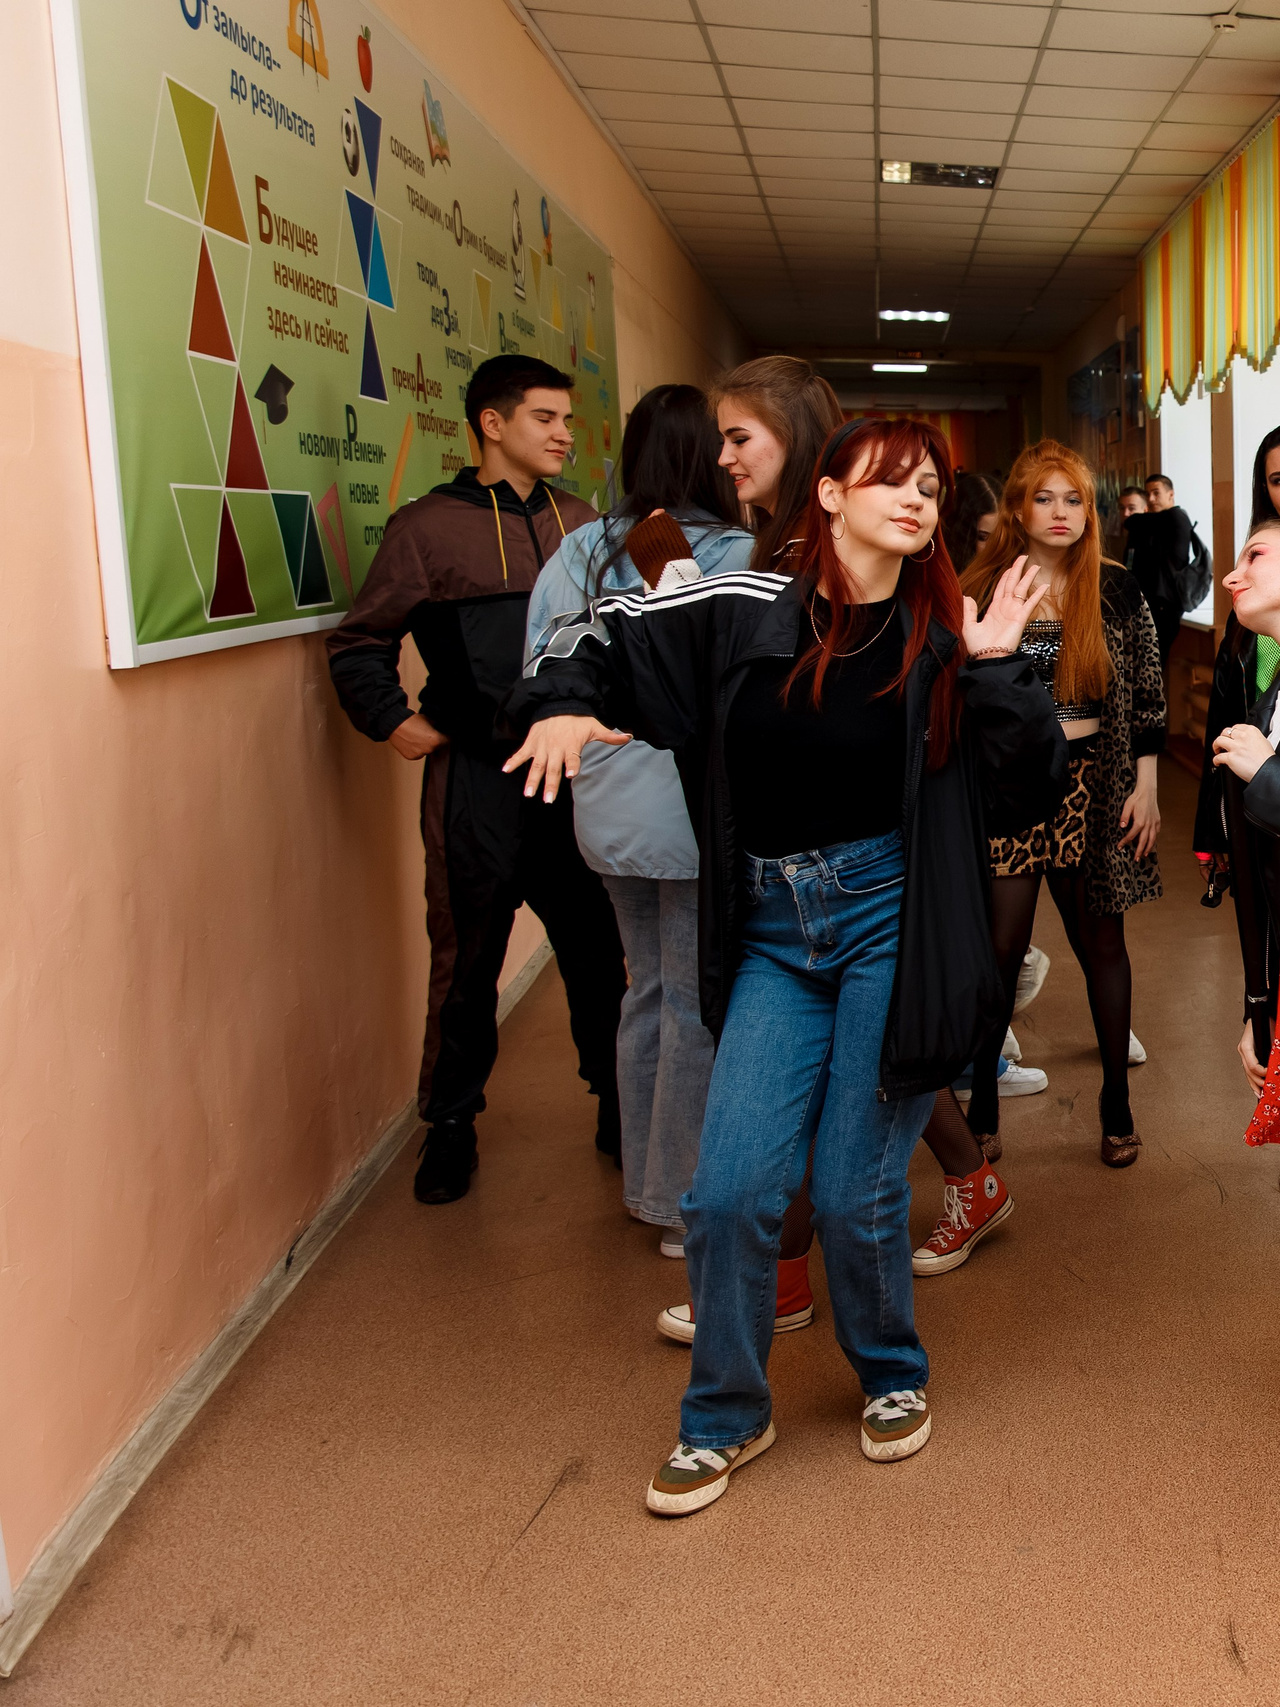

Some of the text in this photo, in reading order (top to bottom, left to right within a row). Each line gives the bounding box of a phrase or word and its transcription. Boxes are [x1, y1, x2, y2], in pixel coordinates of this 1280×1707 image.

[230, 69, 315, 147] до результата
[390, 135, 425, 178] сохраняя
[255, 174, 318, 257] Будущее
[406, 184, 444, 231] традиции,
[273, 261, 338, 308] начинается
[416, 261, 440, 295] твори,
[267, 306, 349, 355] здесь и сейчас
[431, 288, 461, 337] дерЗай,
[392, 352, 443, 404] прекрАсное
[299, 404, 387, 467] новому вРемени-
[416, 408, 459, 440] пробуждает
[441, 447, 466, 482] доброе
[349, 482, 380, 505] новые
[364, 525, 386, 546] откр
